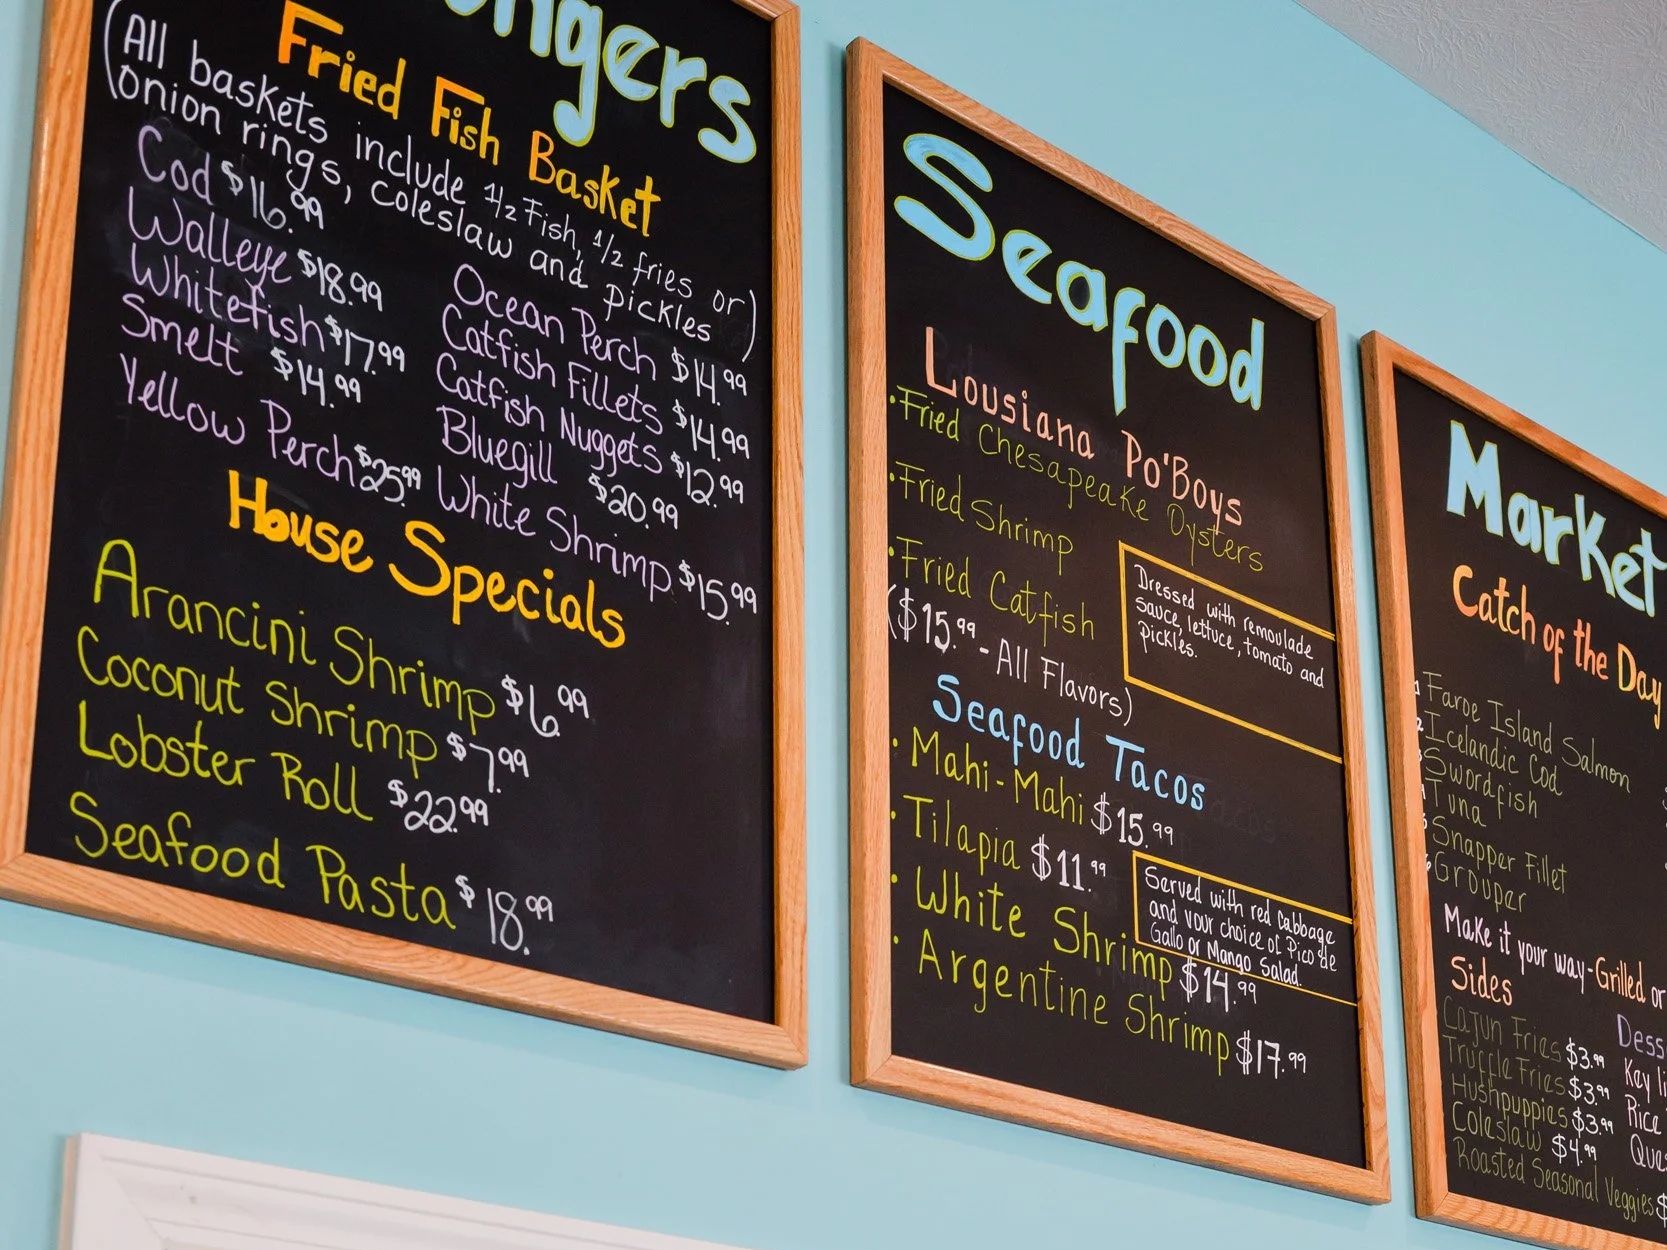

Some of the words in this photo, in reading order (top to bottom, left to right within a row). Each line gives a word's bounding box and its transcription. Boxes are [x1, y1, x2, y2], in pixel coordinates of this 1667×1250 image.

[278, 0, 406, 120] Fried
[431, 76, 499, 165] Fish
[529, 130, 661, 236] Basket
[445, 0, 757, 164] ngers
[118, 65, 221, 135] onion
[243, 121, 352, 204] rings,
[529, 250, 588, 288] and
[138, 125, 214, 205] Cod
[221, 160, 324, 234] $16.99
[190, 39, 327, 143] baskets
[356, 121, 466, 204] include
[633, 252, 692, 298] fries
[128, 186, 291, 289] Walleye
[298, 248, 383, 312] $18.99
[131, 243, 325, 352] Whitefish
[324, 314, 405, 375] $17.99
[893, 133, 1265, 416] Seafood
[121, 293, 244, 375] Smelt
[270, 346, 362, 408] $14.99
[442, 303, 556, 388] Catfish
[567, 361, 663, 435] Fillets
[671, 398, 750, 462] $14.99
[453, 263, 565, 344] Ocean
[571, 307, 656, 381] Perch
[671, 346, 747, 406] $14.99
[120, 353, 246, 445] Yellow
[260, 399, 355, 487] Perch
[353, 443, 421, 507] $25.99
[435, 404, 558, 489] Bluegill
[588, 472, 679, 529] $20.99
[436, 352, 545, 432] Catfish
[560, 406, 663, 477] Nuggets
[670, 450, 743, 508] $12.99
[897, 385, 960, 441] Fried
[979, 423, 1149, 521] Chesapeake
[1167, 503, 1263, 572] Oysters
[925, 326, 1095, 460] Lousiana
[1121, 429, 1242, 535] Po'Boys
[228, 469, 374, 573] House
[388, 520, 626, 649] Specials
[437, 465, 536, 537] White
[546, 505, 672, 602] Shrimp
[678, 559, 757, 626] $15.99
[896, 461, 964, 522] Fried
[971, 499, 1074, 576] Shrimp
[1446, 419, 1667, 617] Market
[93, 539, 317, 666] Arancini
[329, 626, 496, 735] Shrimp
[896, 536, 971, 599] Fried
[990, 570, 1094, 647] Catfish
[1134, 563, 1195, 610] Dressed
[1206, 602, 1236, 628] with
[1243, 616, 1314, 660] remoulade
[1187, 614, 1241, 658] lettuce,
[1243, 637, 1293, 676] tomato
[1299, 667, 1325, 689] and
[1452, 564, 1536, 645] Catch
[1543, 622, 1565, 684] of
[1573, 618, 1609, 680] the
[1617, 642, 1662, 730] Day
[77, 625, 245, 715] Coconut
[265, 680, 438, 779] Shrimp
[446, 732, 530, 793] $7.99
[932, 674, 1085, 768] Seafood
[1105, 734, 1206, 811] Tacos
[996, 638, 1028, 683] All
[1040, 655, 1133, 727] Flavors)
[1423, 671, 1481, 722] Faroe
[1487, 699, 1552, 754] Island
[1562, 737, 1631, 793] Salmon
[79, 700, 257, 786] Lobster
[271, 751, 373, 822] Roll
[388, 778, 490, 834] $22.99
[911, 726, 1084, 825] Mahi-Mahi
[1090, 791, 1174, 849] $15.99
[1424, 710, 1519, 774] Icelandic
[1529, 753, 1563, 796] Cod
[1424, 747, 1538, 819] Swordfish
[1425, 777, 1487, 827] Tuna
[68, 790, 285, 889] Seafood
[305, 844, 457, 930] Pasta
[455, 874, 554, 955] $18.99
[903, 794, 1021, 876] Tilapia
[1030, 833, 1107, 893] $11.99
[1145, 866, 1202, 904] Served
[1210, 888, 1244, 918] with
[1250, 898, 1272, 927] red
[1432, 815, 1516, 874] Snapper
[1524, 851, 1568, 894] Fillet
[1434, 851, 1527, 913] Grouper
[916, 865, 1026, 938] White
[1053, 905, 1172, 1001] Shrimp
[1179, 955, 1257, 1012] $14.99
[1149, 899, 1178, 925] and
[1220, 917, 1265, 950] choice
[1286, 935, 1315, 965] Pico
[1319, 945, 1337, 972] de
[1150, 921, 1184, 950] Gallo
[1188, 937, 1201, 957] or
[1207, 939, 1252, 975] Mango
[1444, 902, 1492, 948] Make
[1499, 920, 1511, 955] it
[1518, 939, 1548, 975] your
[1651, 986, 1666, 1009] or
[1451, 956, 1513, 1006] Sides
[918, 928, 1108, 1025] Argentine
[1125, 993, 1230, 1077] Shrimp
[1235, 1029, 1307, 1079] $17.99
[1511, 1015, 1562, 1062] Fries
[1565, 1037, 1605, 1070] $3.99
[1617, 1013, 1667, 1060] Dess
[1442, 1034, 1512, 1086] Truffle
[1516, 1057, 1566, 1095] Fries
[1568, 1075, 1610, 1106] $3.99
[1452, 1073, 1568, 1130] Hushpuppies
[1571, 1107, 1614, 1138] $3.99
[1624, 1057, 1650, 1103] Key
[1624, 1094, 1662, 1135] Rice
[1452, 1101, 1542, 1152] Coleslaw
[1551, 1133, 1597, 1166] $4.99
[1452, 1136, 1525, 1184] Roasted
[1532, 1157, 1599, 1202] Seasonal
[1605, 1176, 1654, 1222] Veggies
